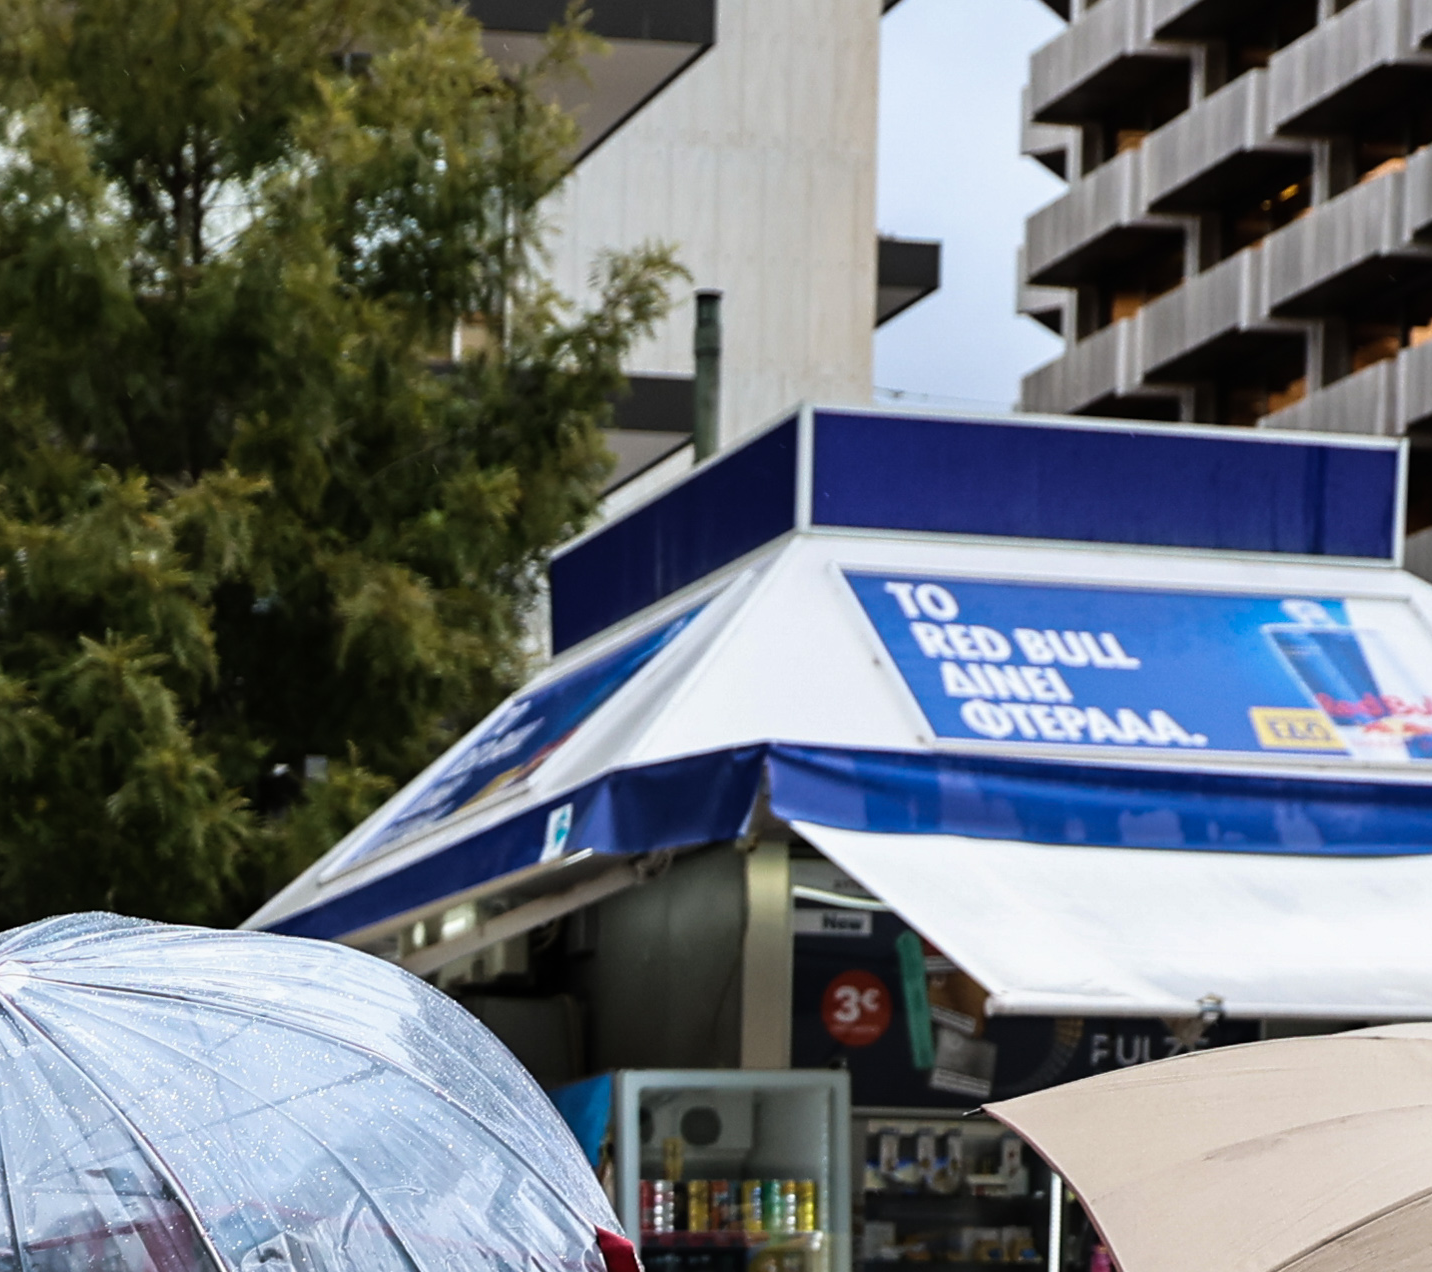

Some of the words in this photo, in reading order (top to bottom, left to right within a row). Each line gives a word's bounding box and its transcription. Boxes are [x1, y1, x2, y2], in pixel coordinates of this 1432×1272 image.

[885, 582, 959, 622] ΤΟ
[910, 621, 1012, 663] RED
[1012, 627, 1141, 670] BULL
[940, 661, 1074, 703] ΔΙΝΕΙ
[833, 985, 881, 1023] 3€
